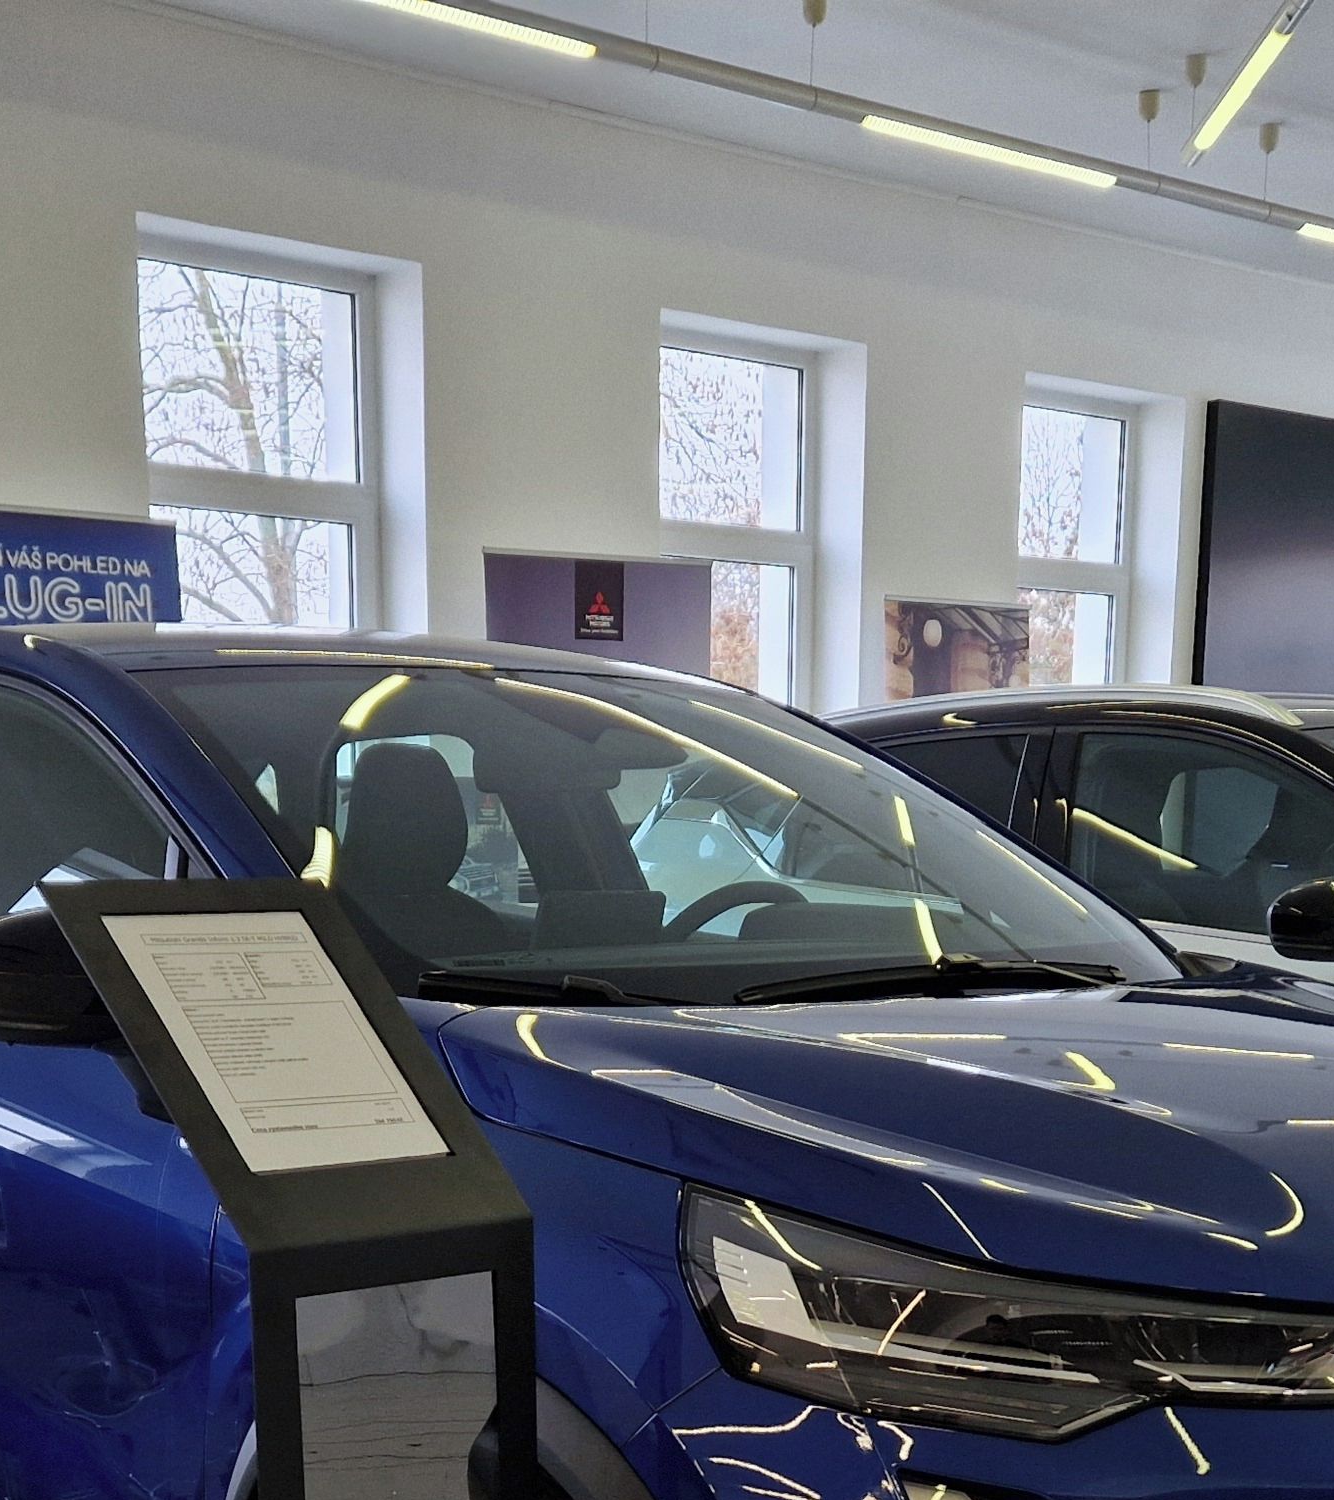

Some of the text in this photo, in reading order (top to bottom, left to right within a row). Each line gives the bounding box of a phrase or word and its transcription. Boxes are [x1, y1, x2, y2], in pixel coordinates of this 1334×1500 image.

[6, 545, 42, 570] VÁŠ
[46, 553, 121, 576] POHLED
[123, 558, 152, 578] NA
